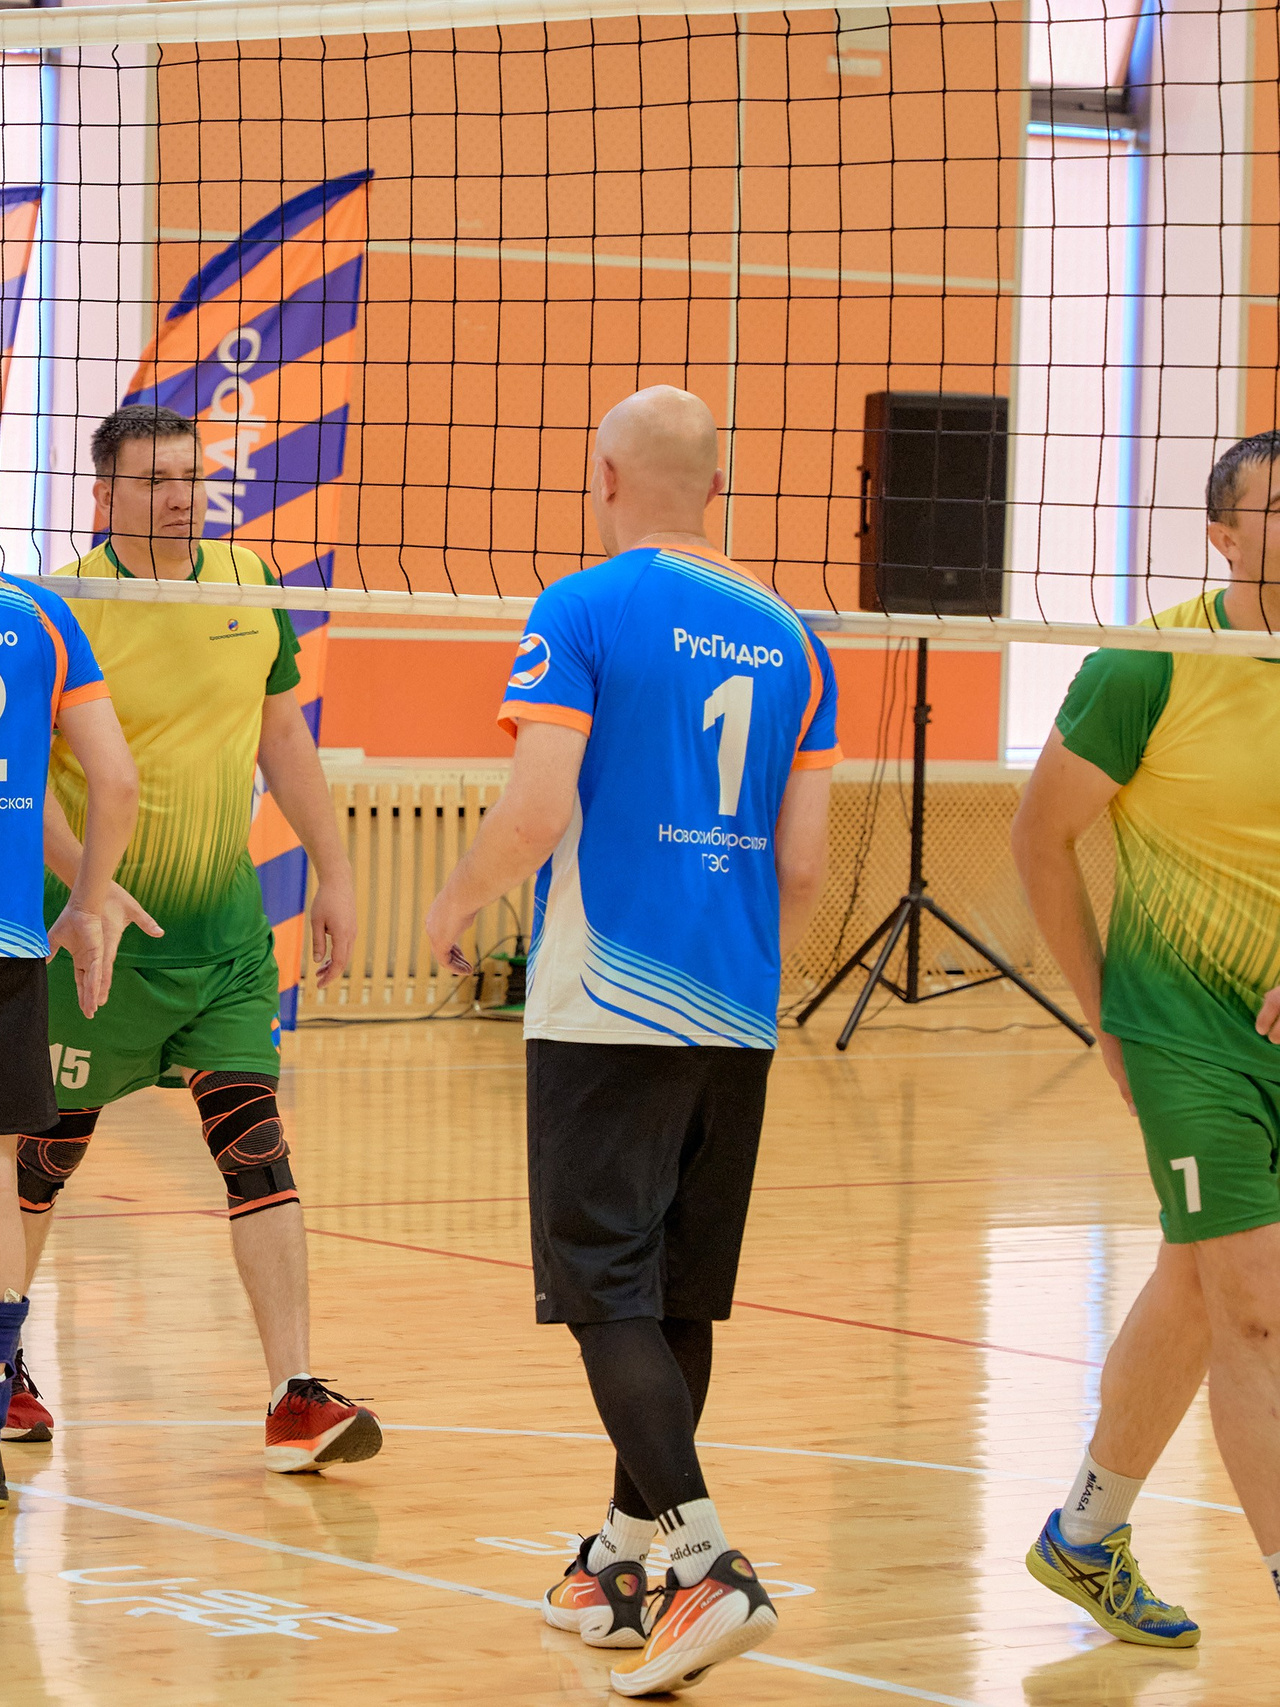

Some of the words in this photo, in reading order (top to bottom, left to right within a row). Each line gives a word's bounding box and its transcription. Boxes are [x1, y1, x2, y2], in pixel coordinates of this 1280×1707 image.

[673, 627, 783, 668] РусГидро
[703, 674, 754, 816] 1
[701, 852, 730, 873] ГЭС
[49, 1043, 91, 1089] 15
[1169, 1156, 1202, 1213] 1
[1076, 1470, 1096, 1511] MIKASA
